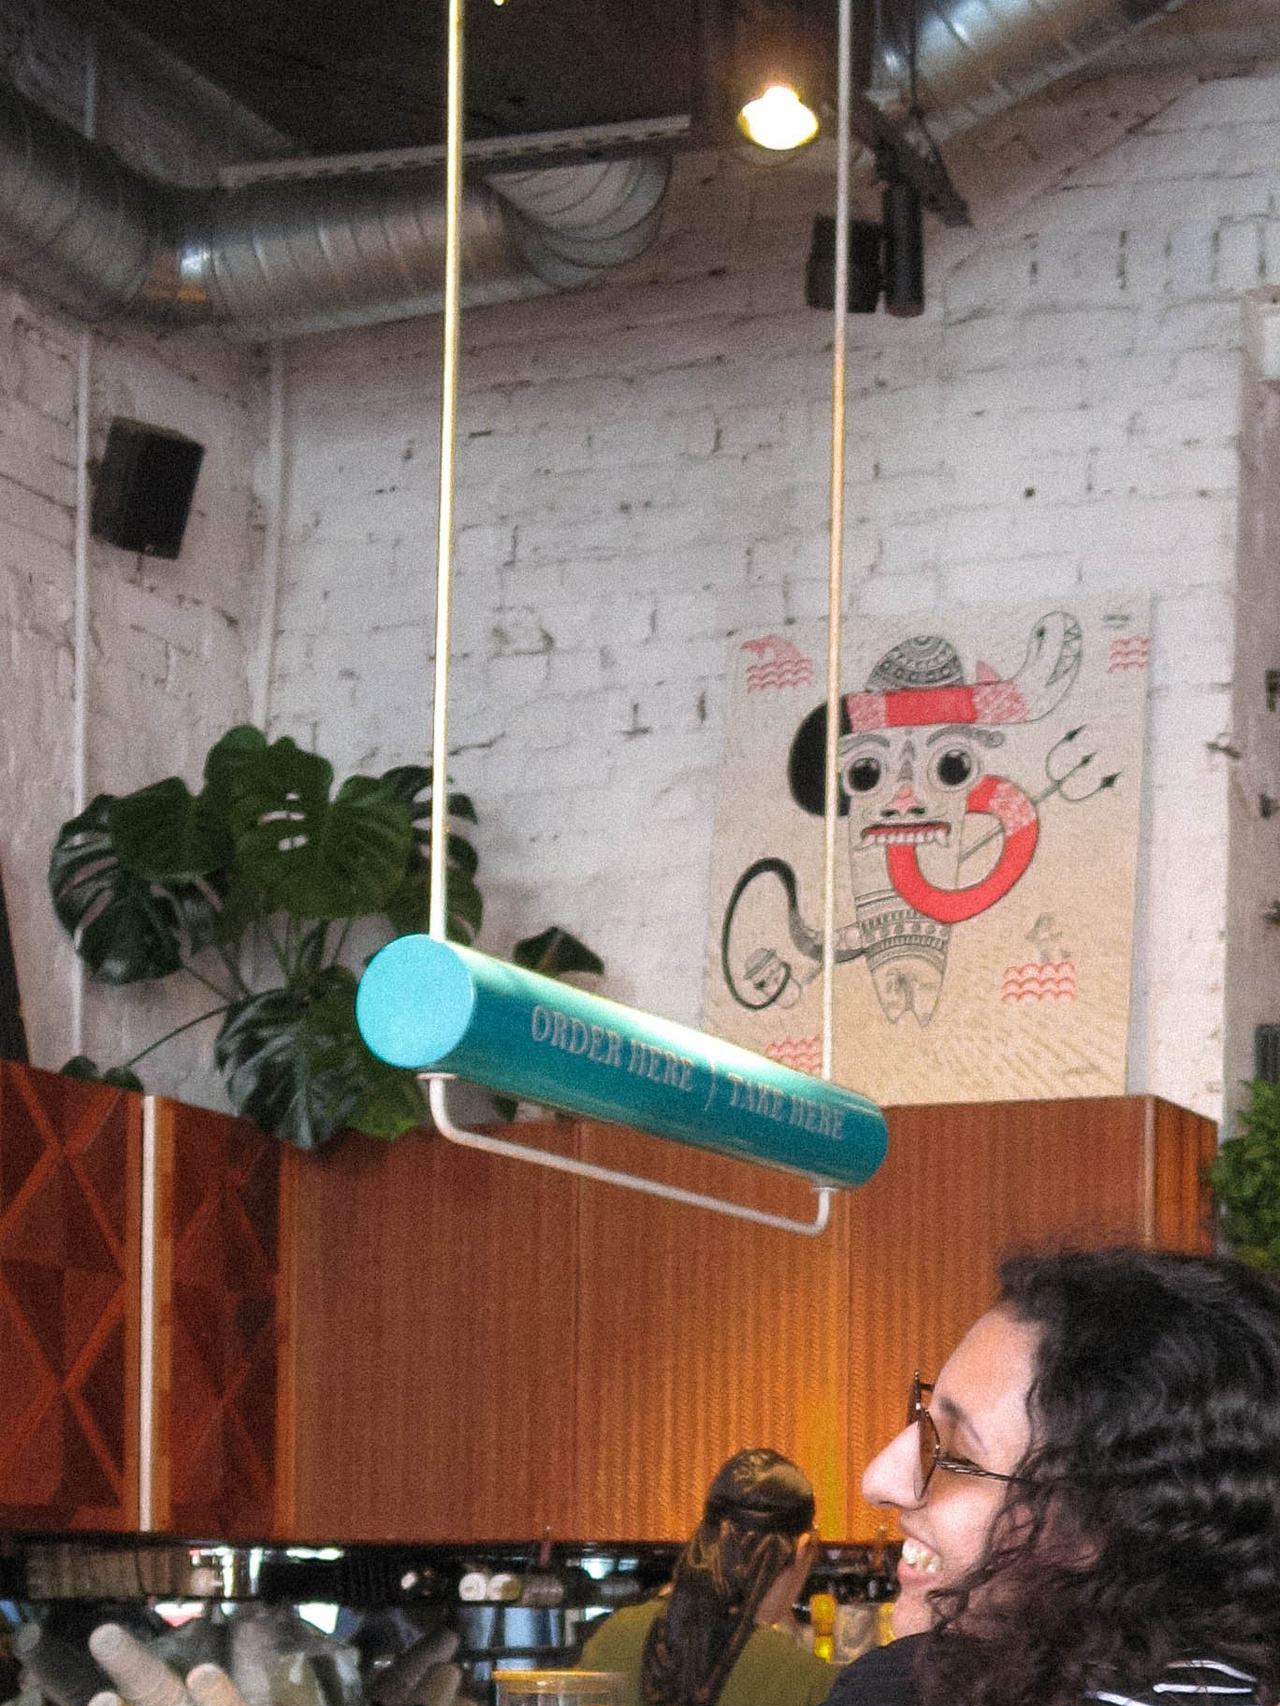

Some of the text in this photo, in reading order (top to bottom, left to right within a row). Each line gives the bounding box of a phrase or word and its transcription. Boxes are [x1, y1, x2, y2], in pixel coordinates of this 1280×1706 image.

[531, 1004, 622, 1067] ORDER
[628, 1038, 694, 1092] HERE
[727, 1073, 785, 1121] TAKE
[789, 1094, 845, 1140] HERE
